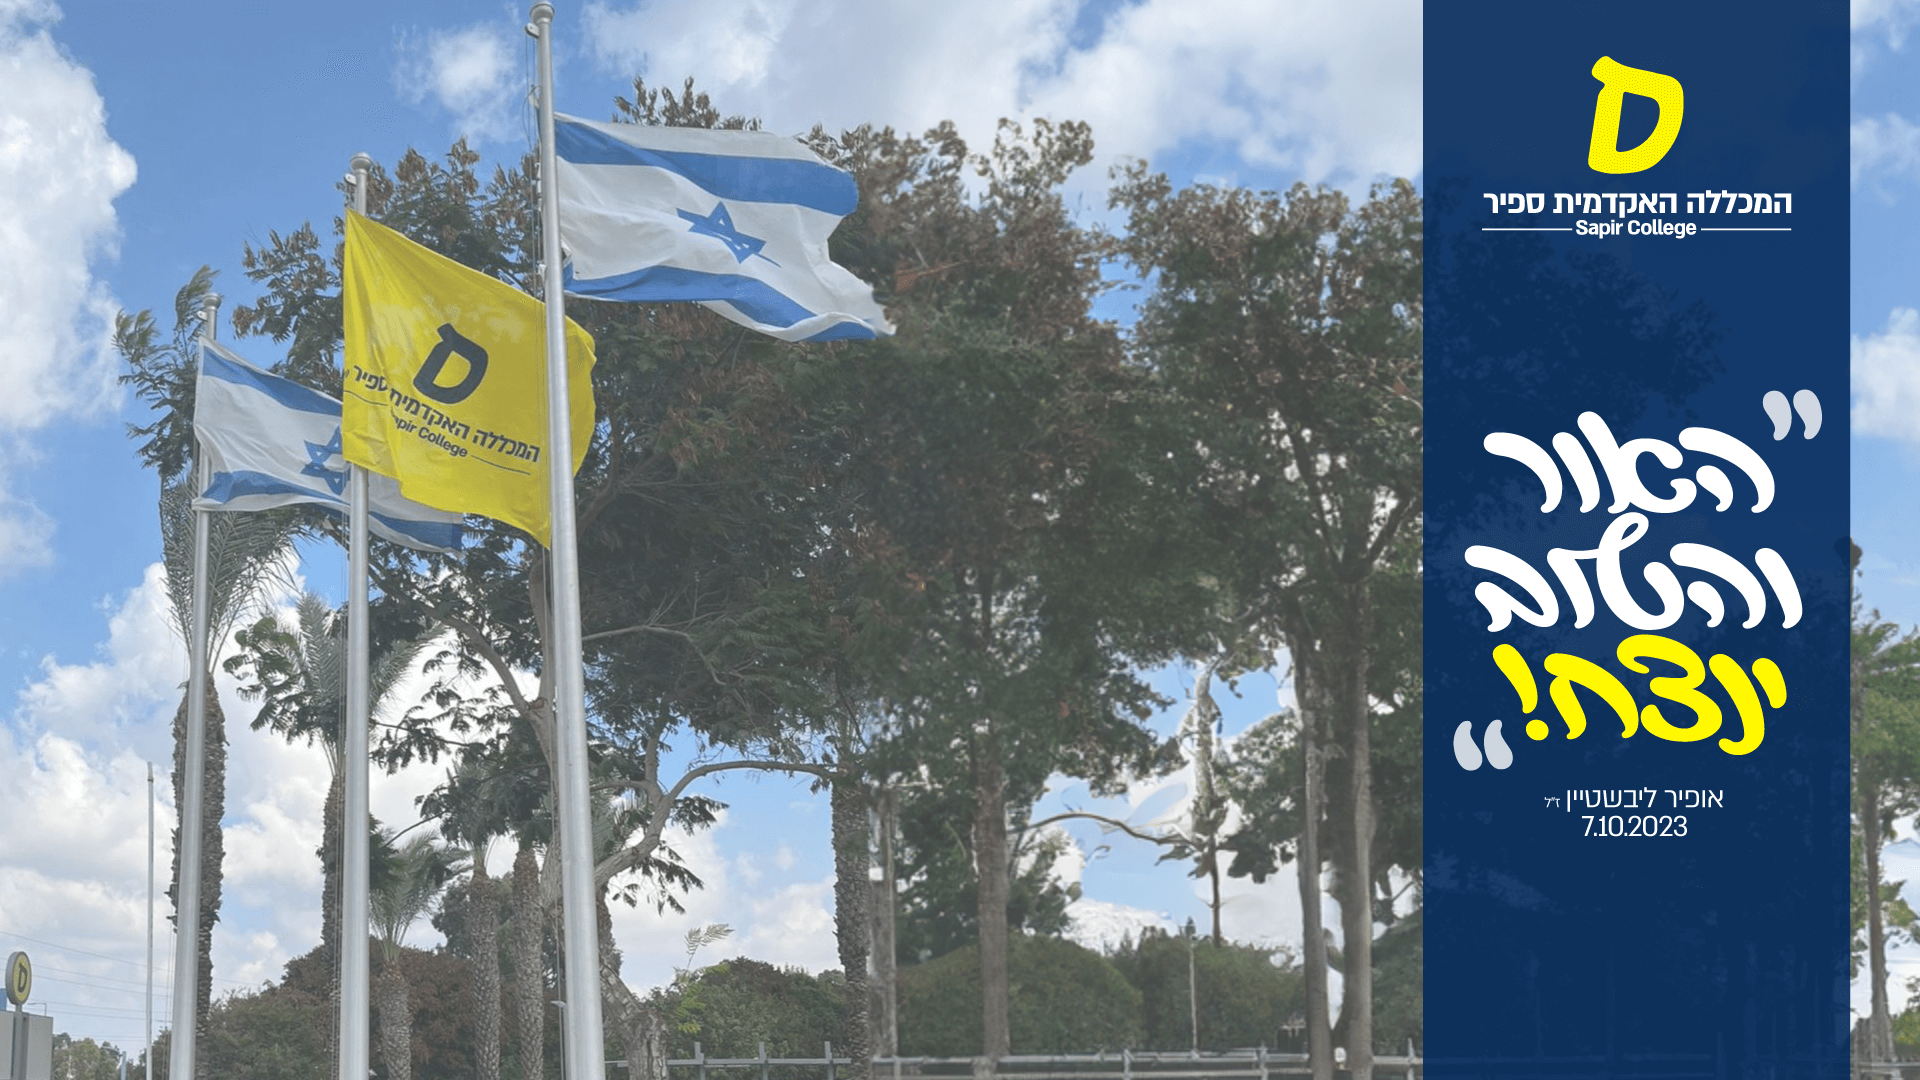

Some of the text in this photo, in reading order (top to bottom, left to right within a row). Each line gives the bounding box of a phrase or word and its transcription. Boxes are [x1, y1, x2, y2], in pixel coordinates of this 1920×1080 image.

[389, 387, 470, 440] האקדמית
[418, 426, 468, 457] College
[471, 429, 540, 463] המכללה
